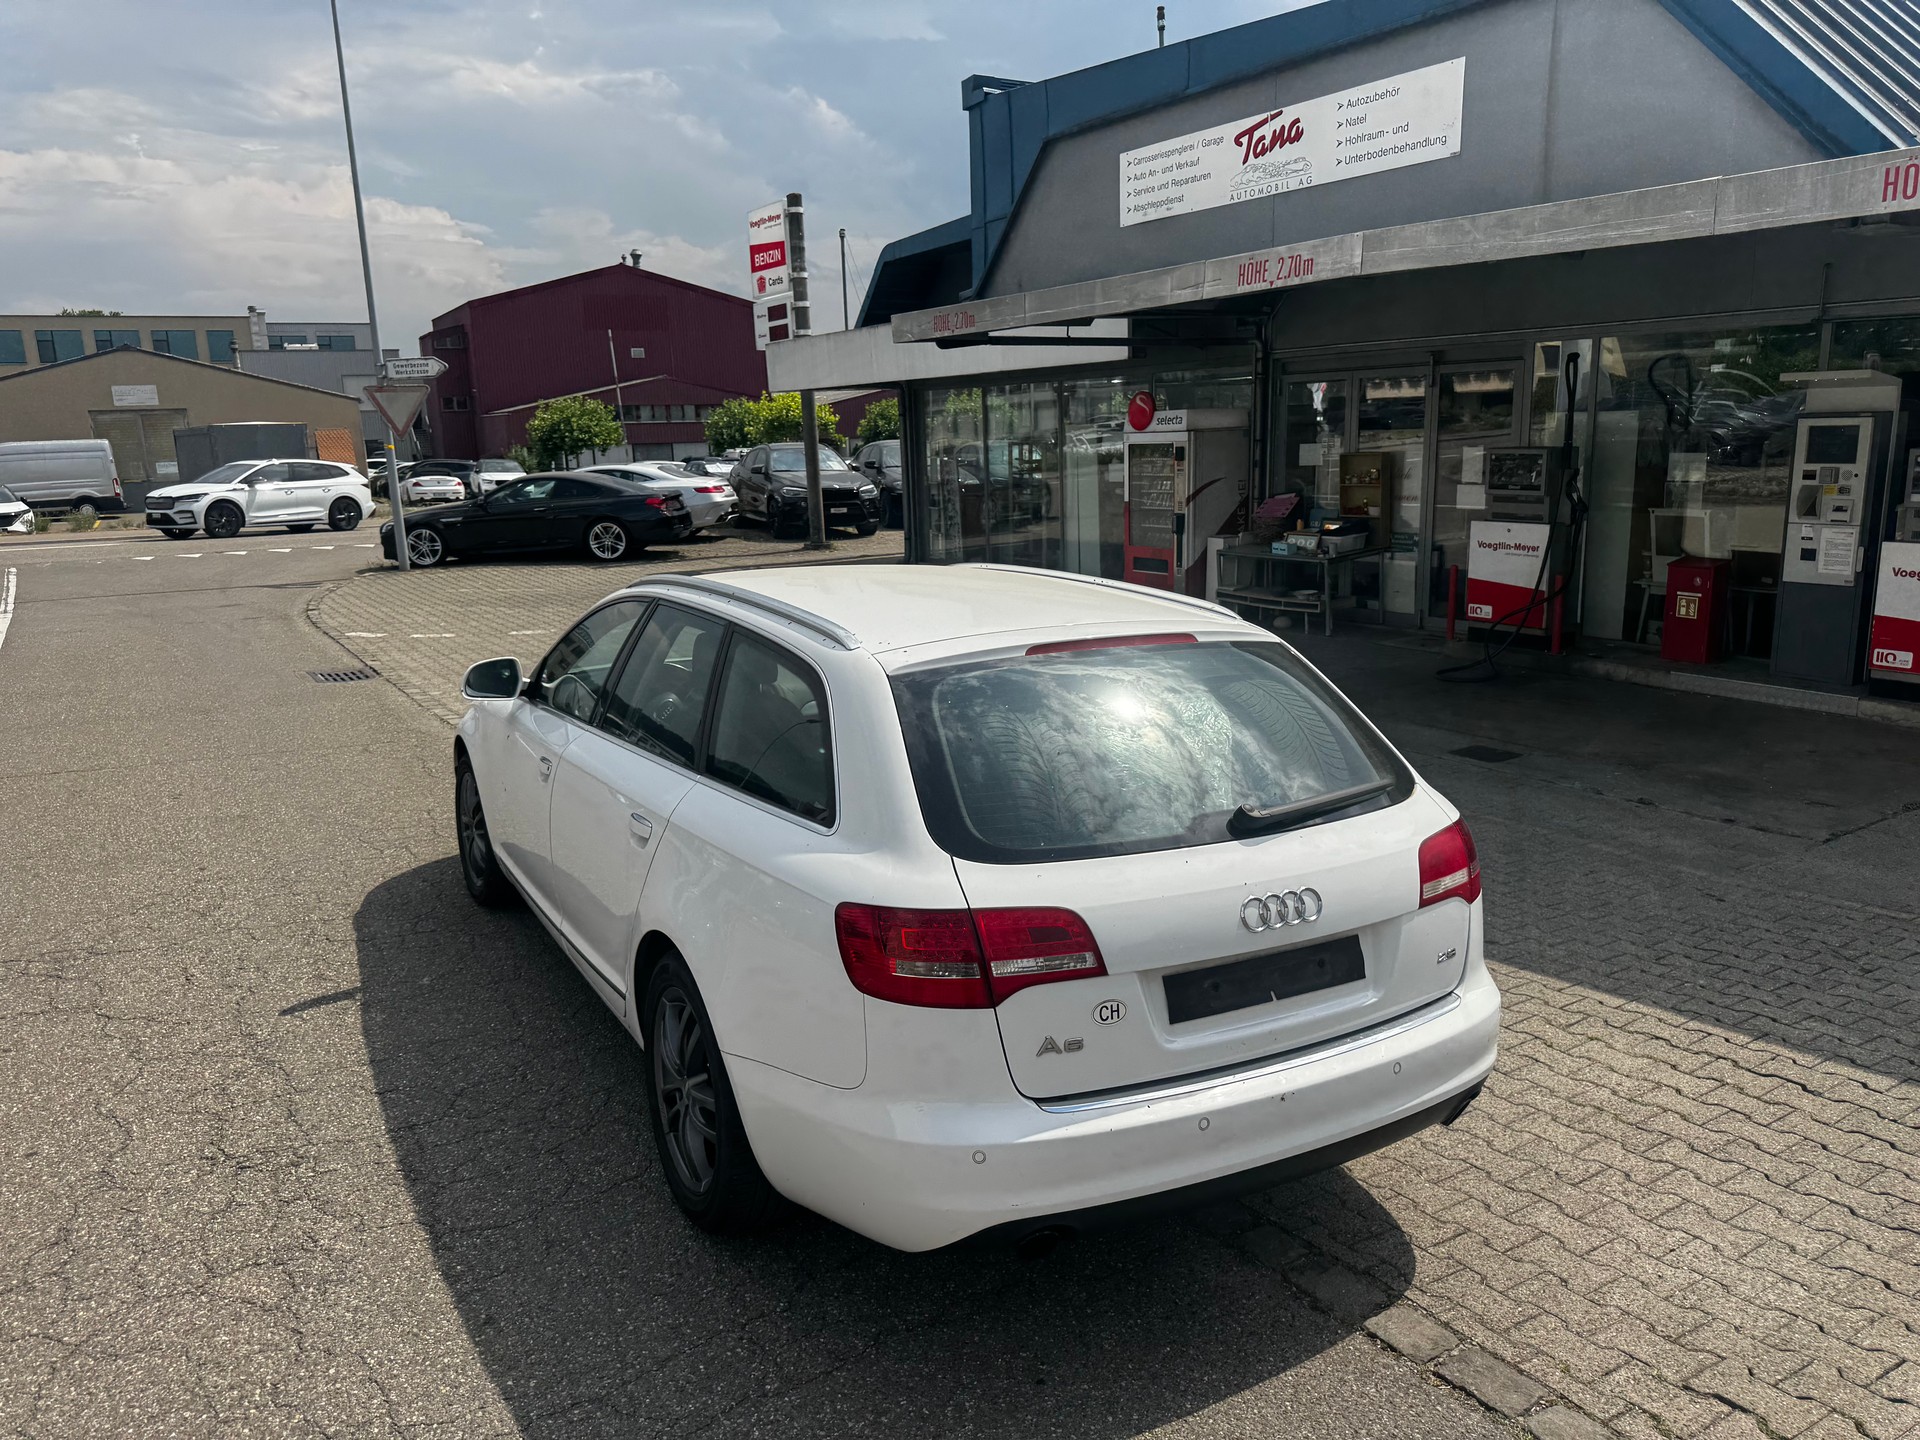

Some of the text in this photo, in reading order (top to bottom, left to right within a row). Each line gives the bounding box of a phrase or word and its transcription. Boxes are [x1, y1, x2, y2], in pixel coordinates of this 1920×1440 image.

[1346, 86, 1401, 110] Autozubehör
[1345, 113, 1367, 128] Natel
[1234, 109, 1305, 166] Tana
[1345, 121, 1409, 147] Hohlraum- und
[1133, 143, 1195, 167] Carrosseriespenglerei
[1201, 135, 1225, 148] Garage
[1344, 135, 1447, 165] Unterbodenbehandlung
[1133, 156, 1201, 182] Auto An- und Verkauf
[1132, 172, 1212, 198] Service und Reparaturen
[1229, 176, 1313, 202] AUTOMOBIL AG
[1133, 194, 1185, 213] Abschleppdienst
[755, 248, 781, 267] BENZIN
[768, 275, 784, 287] Cards
[1238, 257, 1269, 287] HÖHE
[934, 311, 950, 333] HÖHE
[1156, 415, 1183, 426] selecta
[1477, 539, 1540, 554] Voegtlin-Meyer
[1099, 1003, 1120, 1022] CH
[1035, 1034, 1084, 1058] A6
